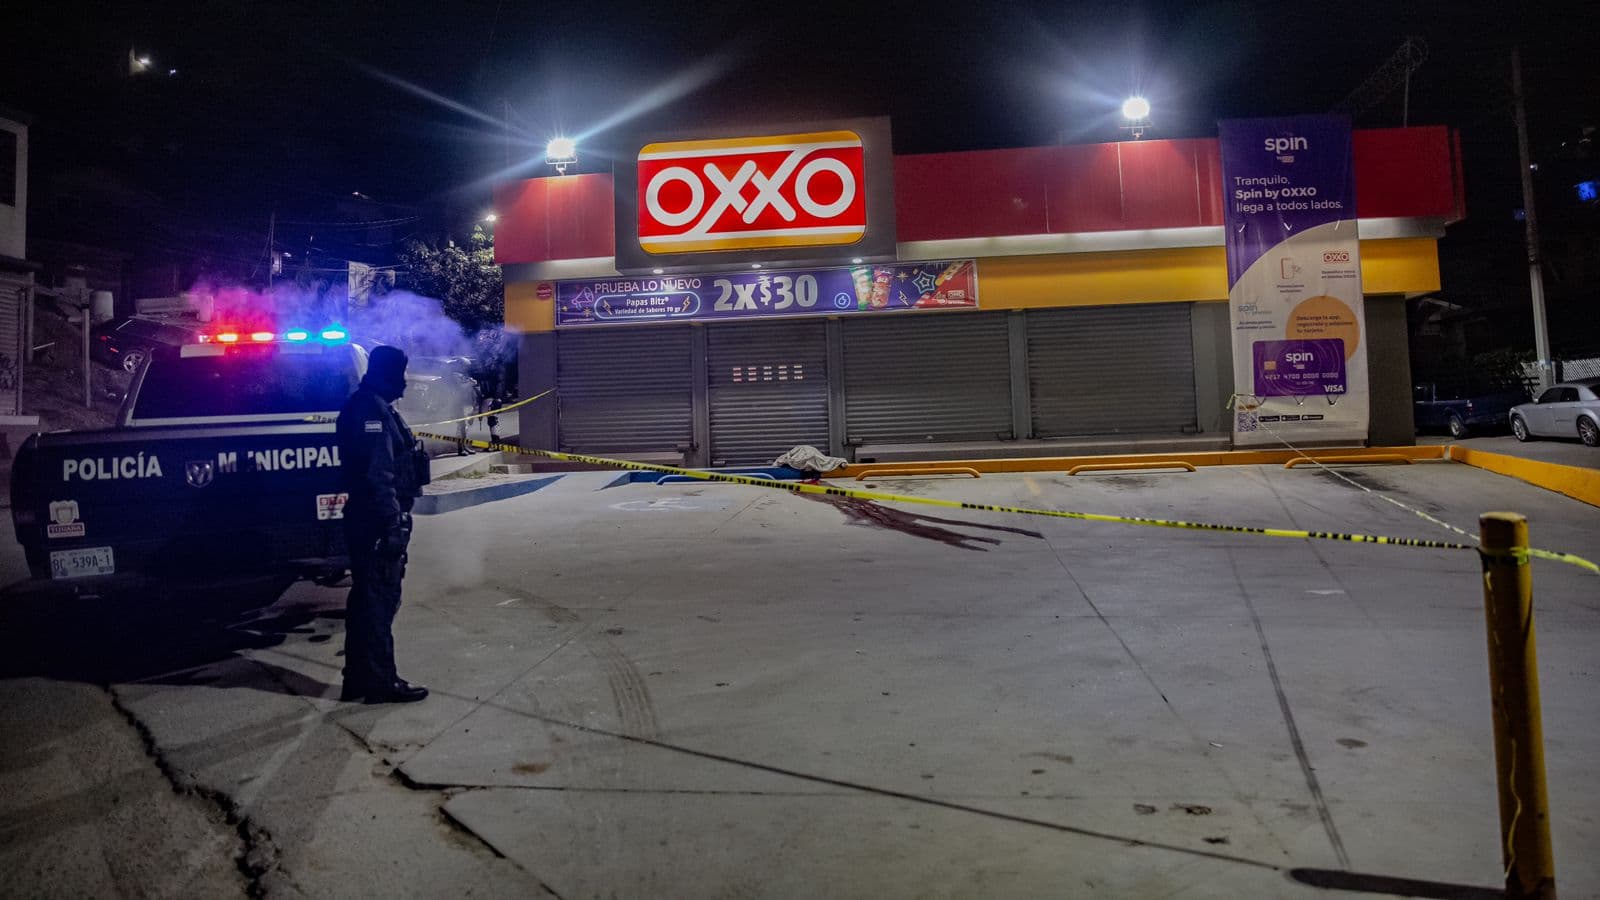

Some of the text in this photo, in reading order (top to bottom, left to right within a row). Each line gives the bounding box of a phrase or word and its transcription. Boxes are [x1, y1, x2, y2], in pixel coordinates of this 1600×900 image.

[1264, 136, 1308, 154] spin
[645, 153, 857, 231] OXXO
[1235, 187, 1317, 200] Spin by OXXO
[1236, 202, 1264, 213] llega
[1276, 201, 1308, 210] todos
[1311, 200, 1343, 209] lados.
[594, 279, 702, 294] PRUEBA LO NUEVO
[626, 298, 648, 307] Papas
[1285, 352, 1314, 363] spin
[1323, 384, 1344, 393] VISA
[63, 446, 342, 481] POLICÍA MNICIPAL
